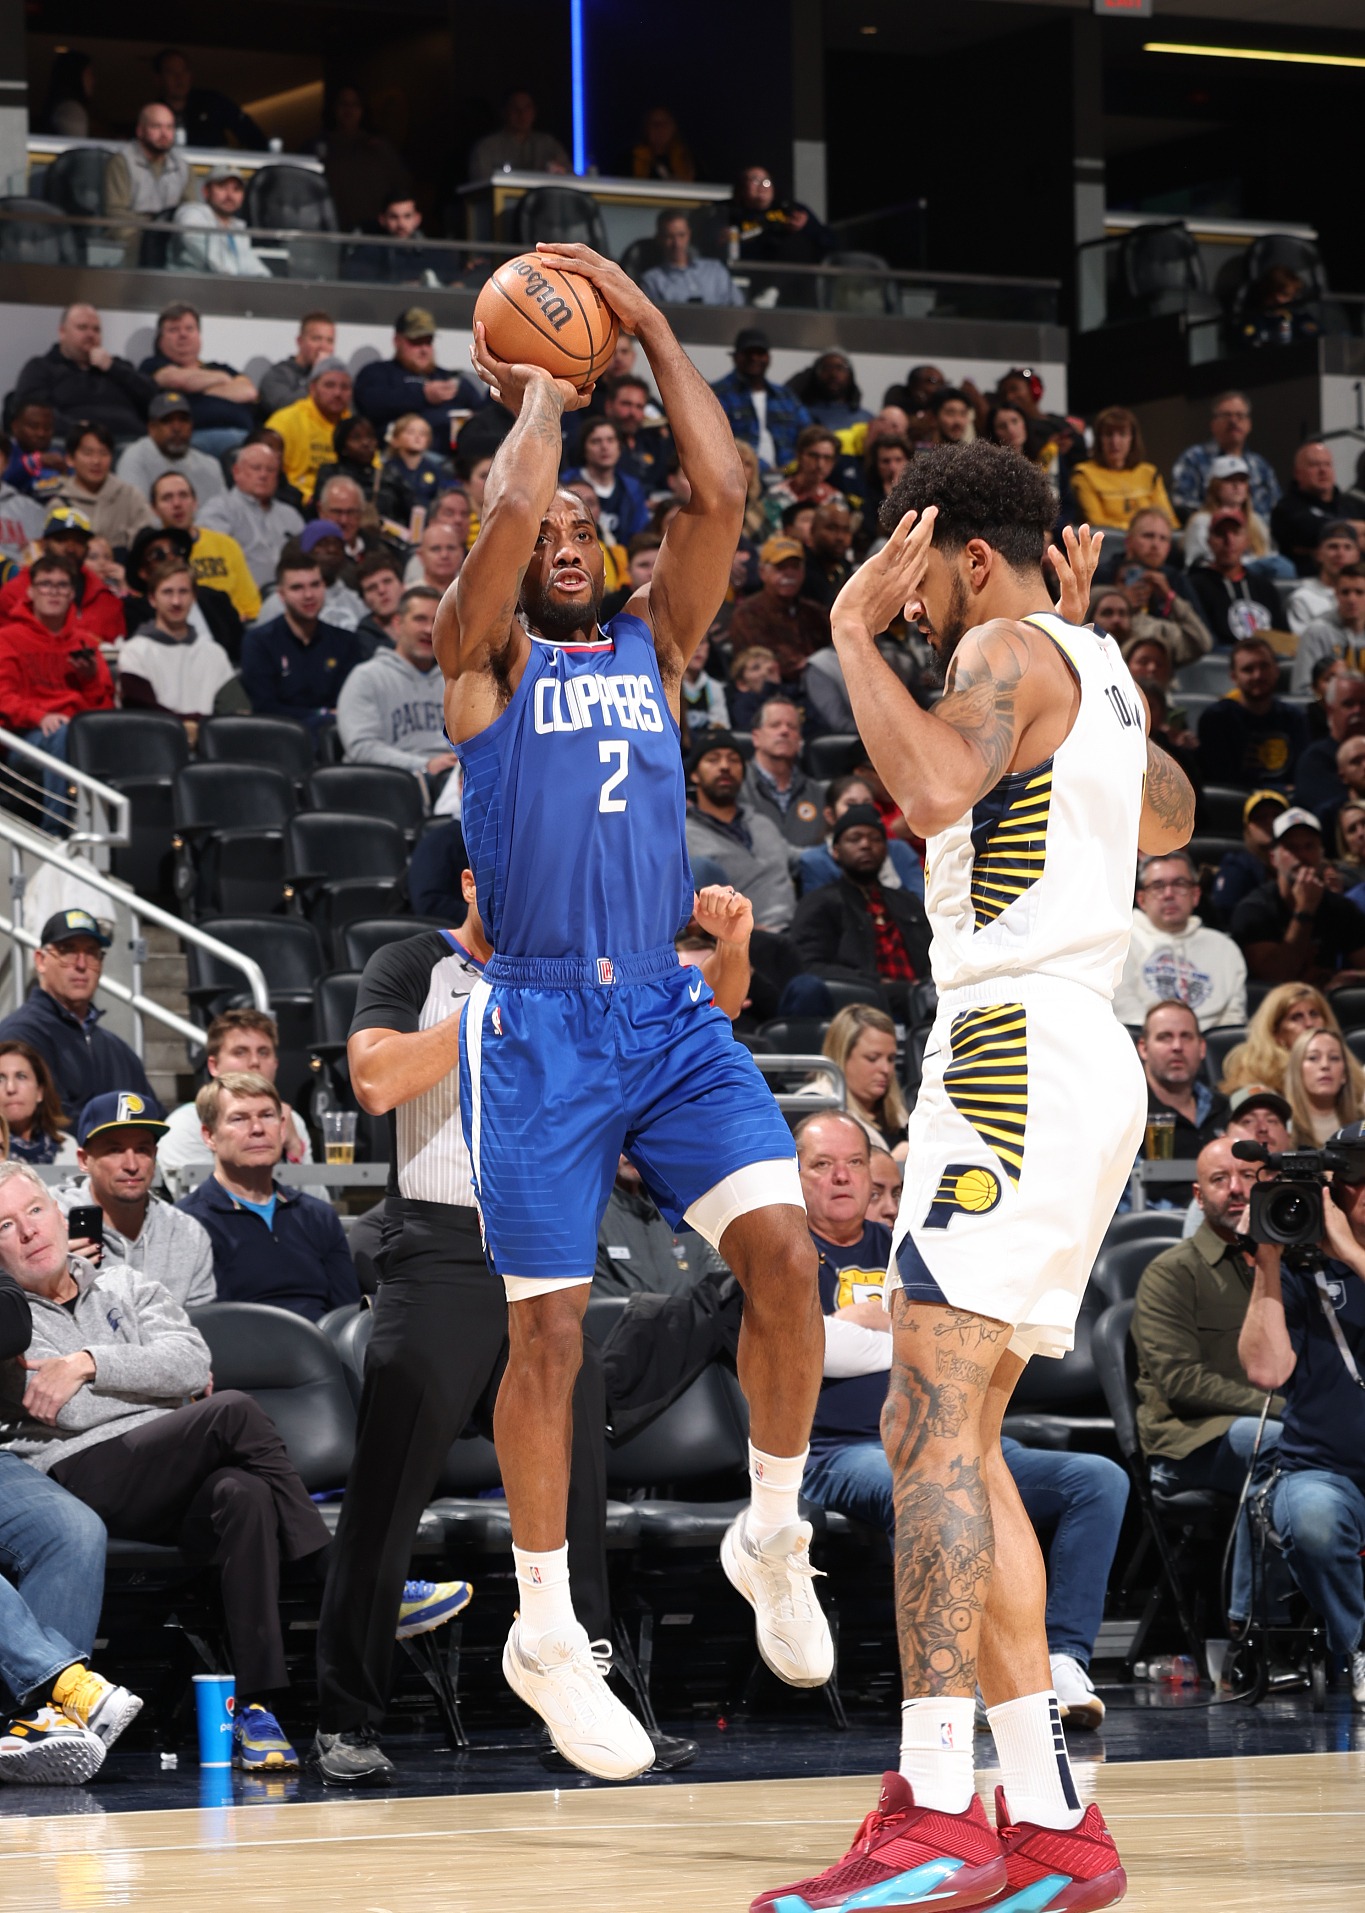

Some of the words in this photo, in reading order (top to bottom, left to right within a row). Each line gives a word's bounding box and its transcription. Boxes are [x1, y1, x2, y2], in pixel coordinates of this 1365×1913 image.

[508, 259, 574, 333] Wilson
[534, 673, 664, 735] CLIPPERS
[598, 739, 629, 813] 2
